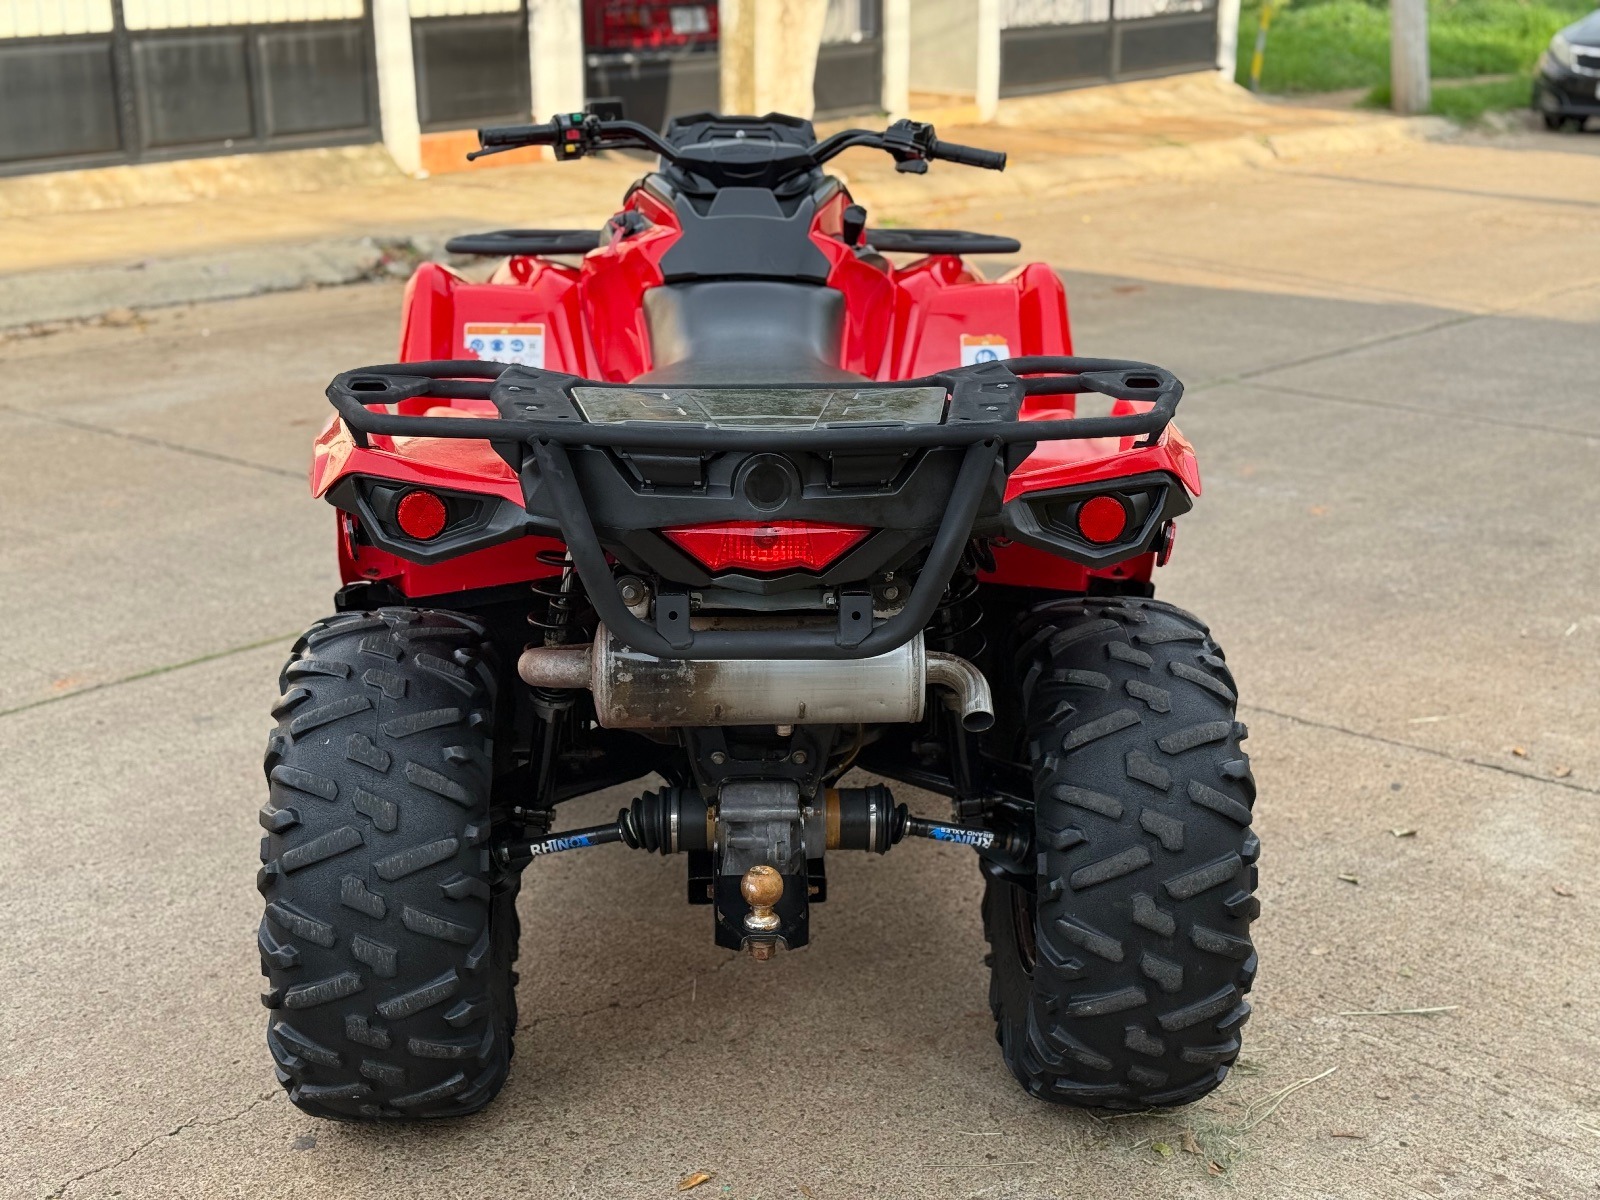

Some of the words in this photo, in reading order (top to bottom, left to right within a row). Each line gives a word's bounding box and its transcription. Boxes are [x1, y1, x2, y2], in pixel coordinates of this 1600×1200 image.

[941, 827, 965, 835] AXLES
[967, 830, 995, 839] BRAND
[530, 838, 581, 856] RHINO
[944, 834, 994, 849] RHINO
